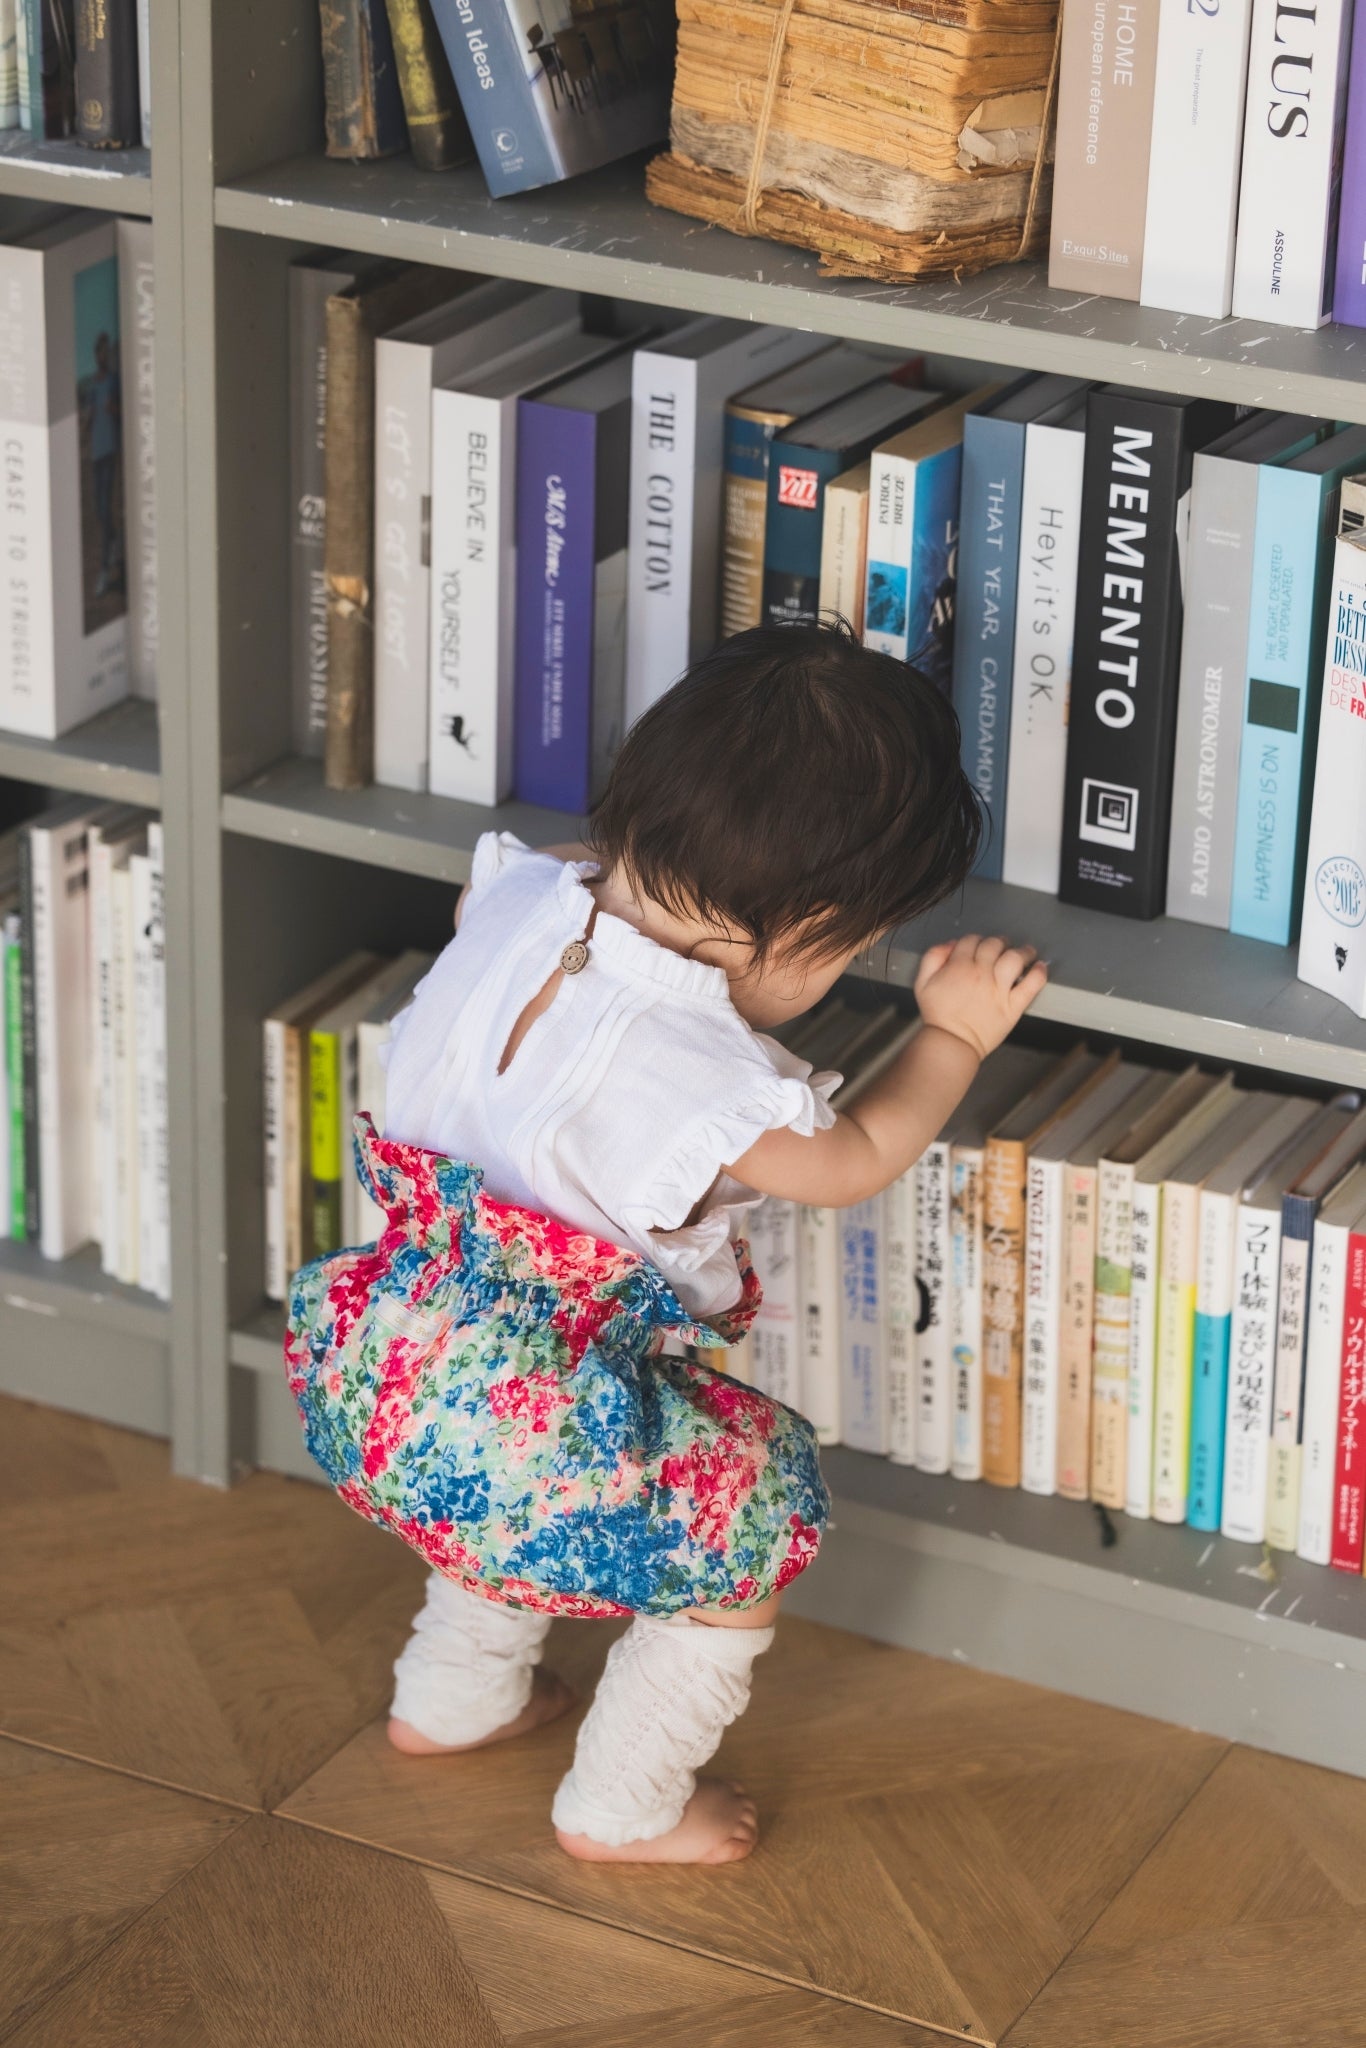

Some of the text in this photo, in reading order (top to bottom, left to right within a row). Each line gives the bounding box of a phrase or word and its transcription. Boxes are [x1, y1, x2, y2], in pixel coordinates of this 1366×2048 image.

[466, 29, 495, 91] Ideas
[1085, 0, 1107, 165] uropean reference
[1113, 4, 1137, 87] HOME
[1191, 48, 1204, 126] The best preparation
[1270, 229, 1285, 295] ASSOULINE
[4, 438, 26, 515] CEASE
[466, 430, 488, 563] BELIEVE IN
[644, 392, 676, 597] THE COTTON
[779, 473, 817, 502] vin
[878, 472, 891, 525] PATRICK
[8, 533, 27, 562] TO
[986, 477, 1006, 552] THAT
[1094, 425, 1154, 730] MEMENTO
[1268, 543, 1283, 602] DESERTED
[1338, 589, 1354, 605] LE
[10, 576, 32, 697] STRUGGLE
[1264, 642, 1277, 663] THE
[1277, 635, 1290, 663] AND
[1328, 688, 1348, 711] DE
[1330, 668, 1358, 695] DES
[1191, 665, 1223, 898] RADIO ASTRONOMER
[1253, 744, 1281, 902] HAPPINESS IS ON
[1332, 876, 1360, 918] 2013
[1028, 1166, 1045, 1299] SINGLE TASK
[1239, 1221, 1271, 1313] フロー体験
